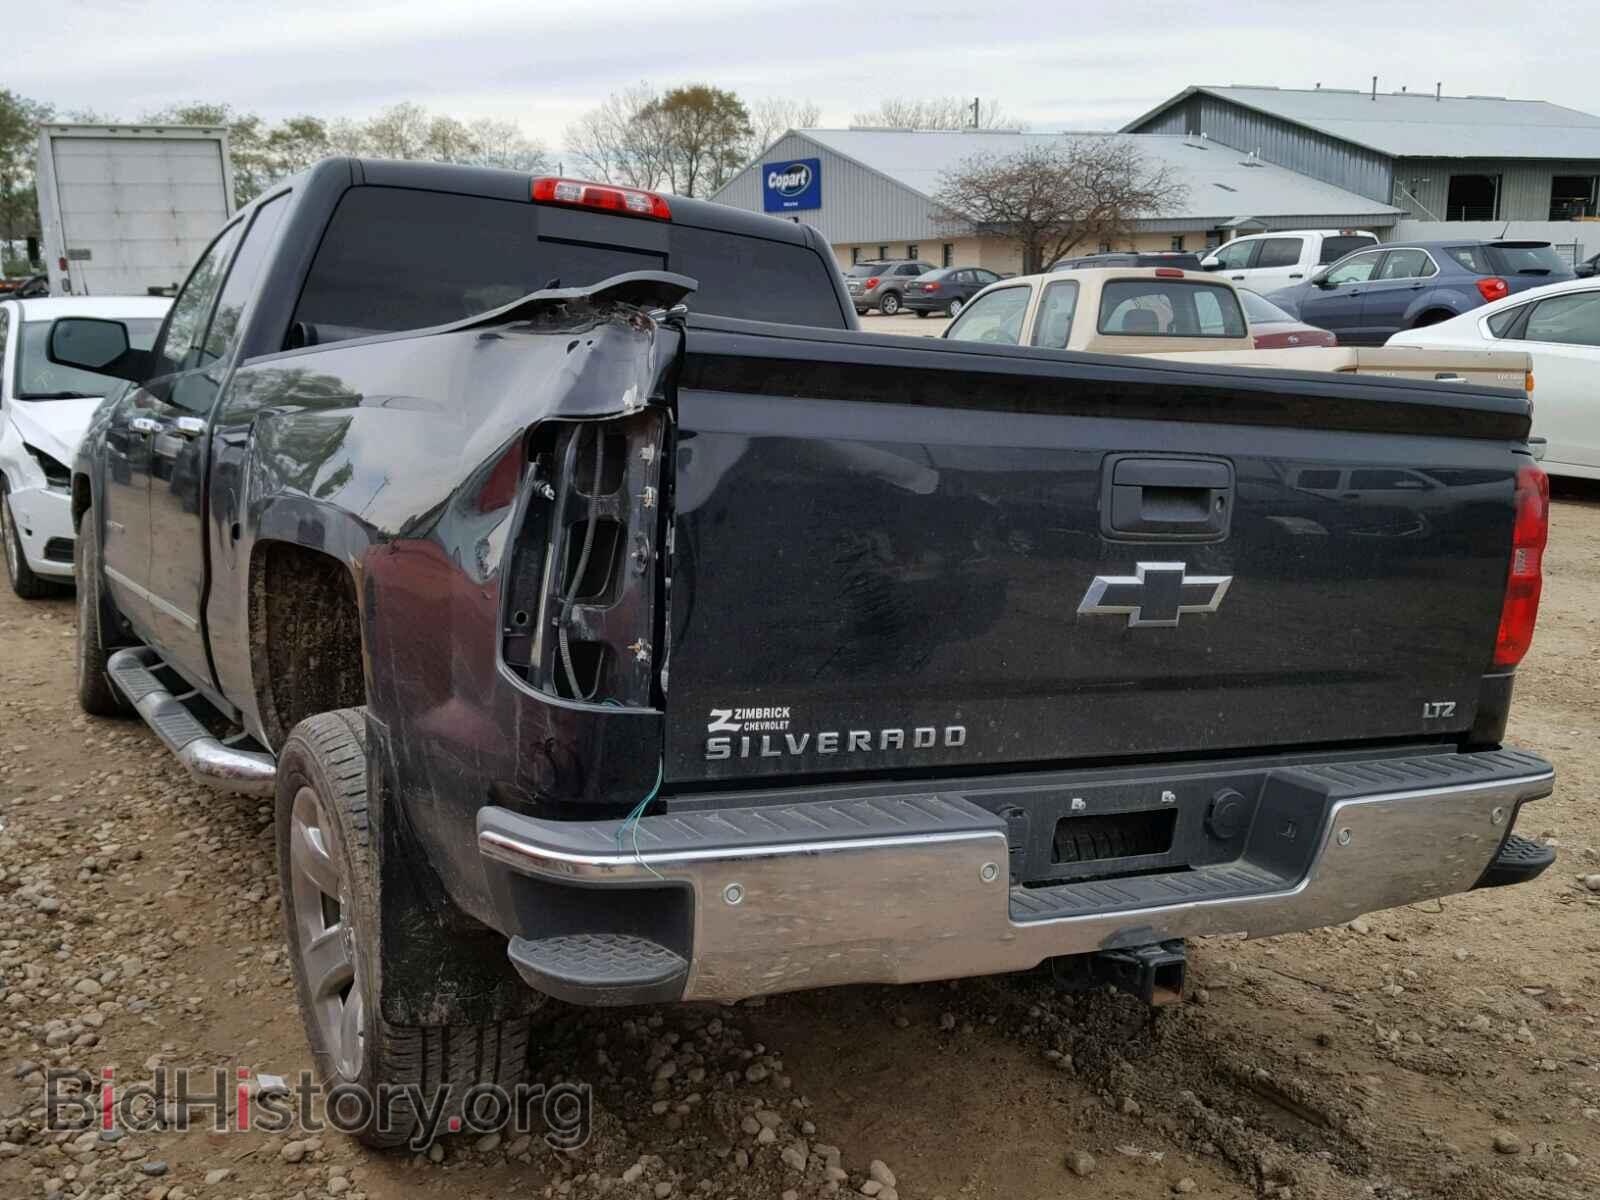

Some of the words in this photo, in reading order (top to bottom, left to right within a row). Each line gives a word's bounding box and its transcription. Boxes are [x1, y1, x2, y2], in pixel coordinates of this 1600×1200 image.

[768, 167, 807, 191] Copart
[733, 706, 791, 720] ZIMBRICK
[1422, 701, 1457, 718] LTZ
[743, 720, 790, 732] CHEVROLET
[705, 725, 967, 760] SILVERADO
